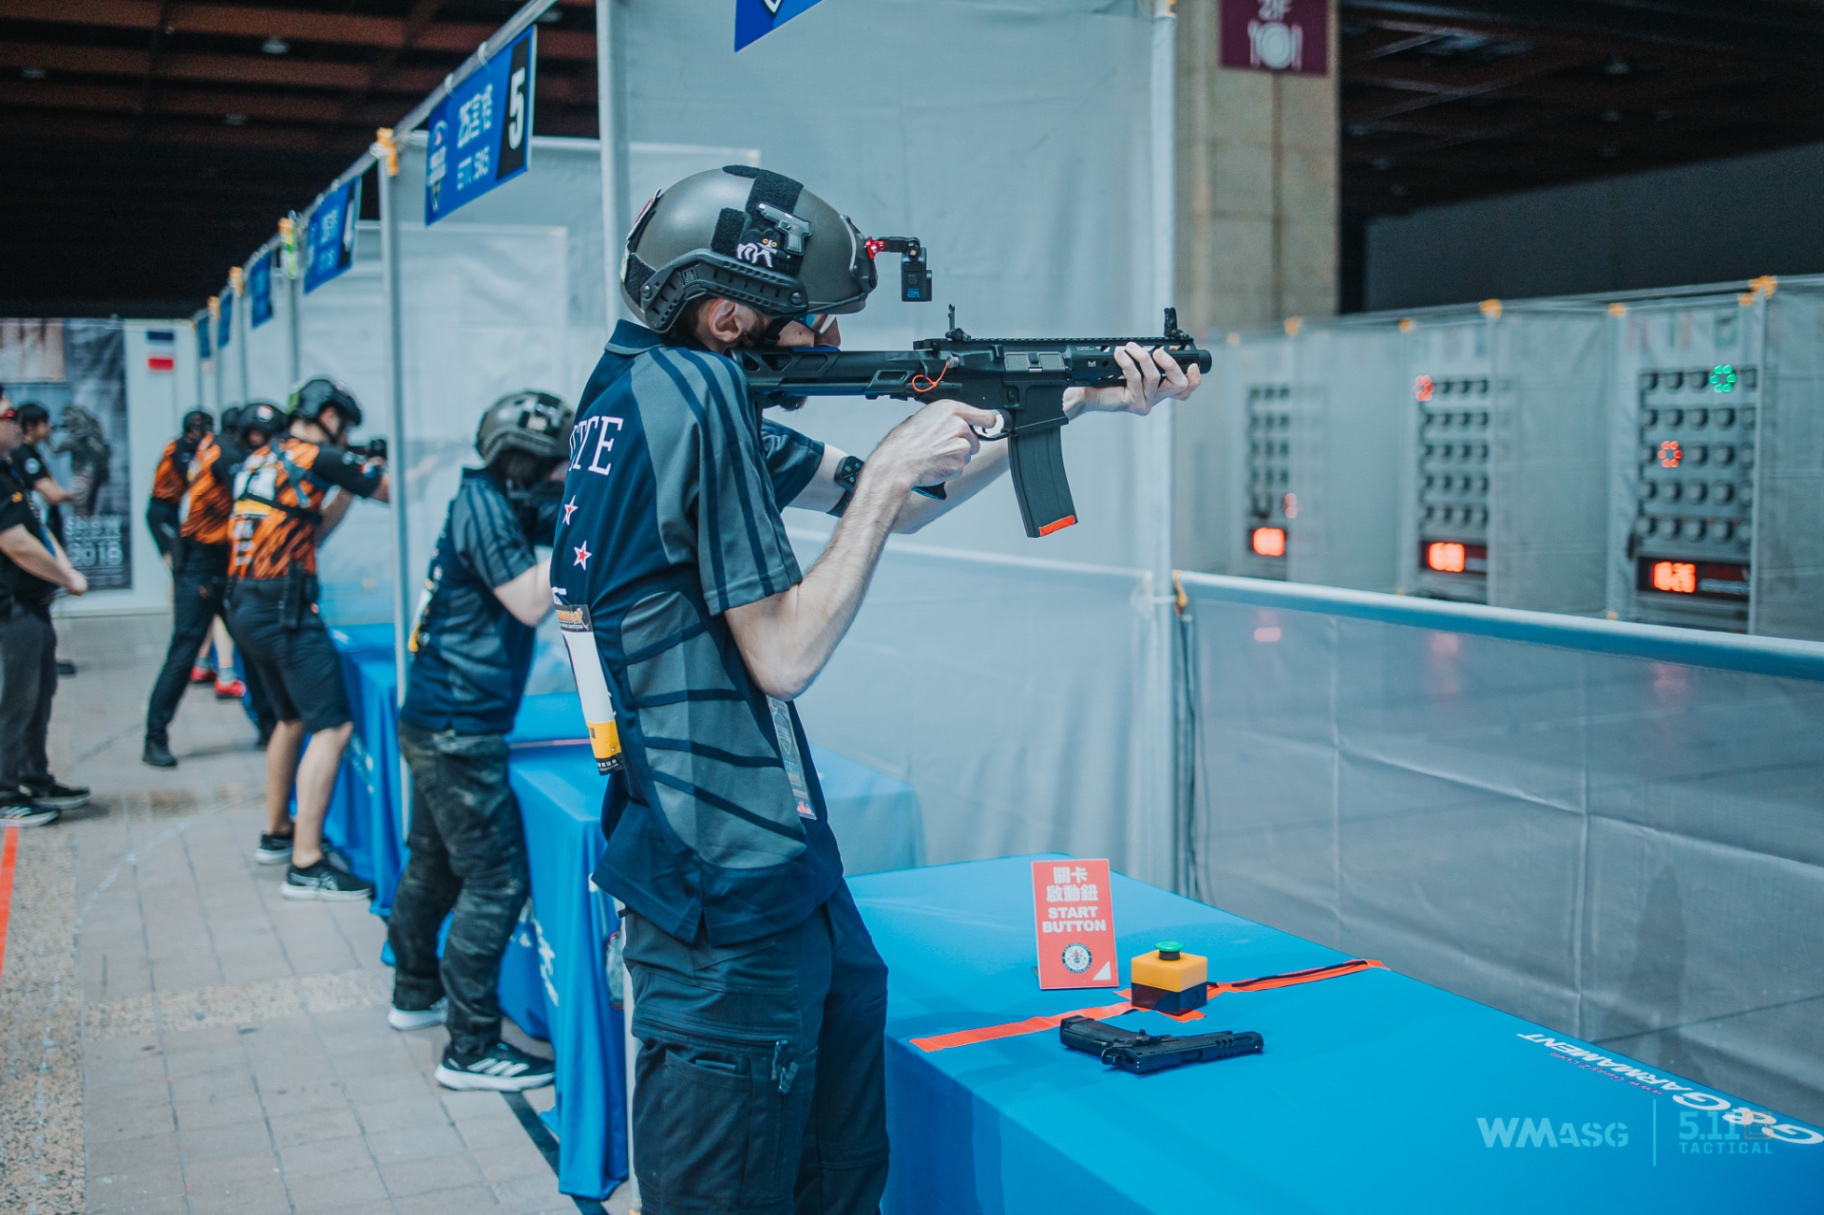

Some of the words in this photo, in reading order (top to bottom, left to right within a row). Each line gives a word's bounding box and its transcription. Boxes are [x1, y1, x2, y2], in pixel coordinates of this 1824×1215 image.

[509, 67, 526, 150] 5
[1048, 906, 1098, 919] START
[1042, 920, 1106, 933] BUTTON
